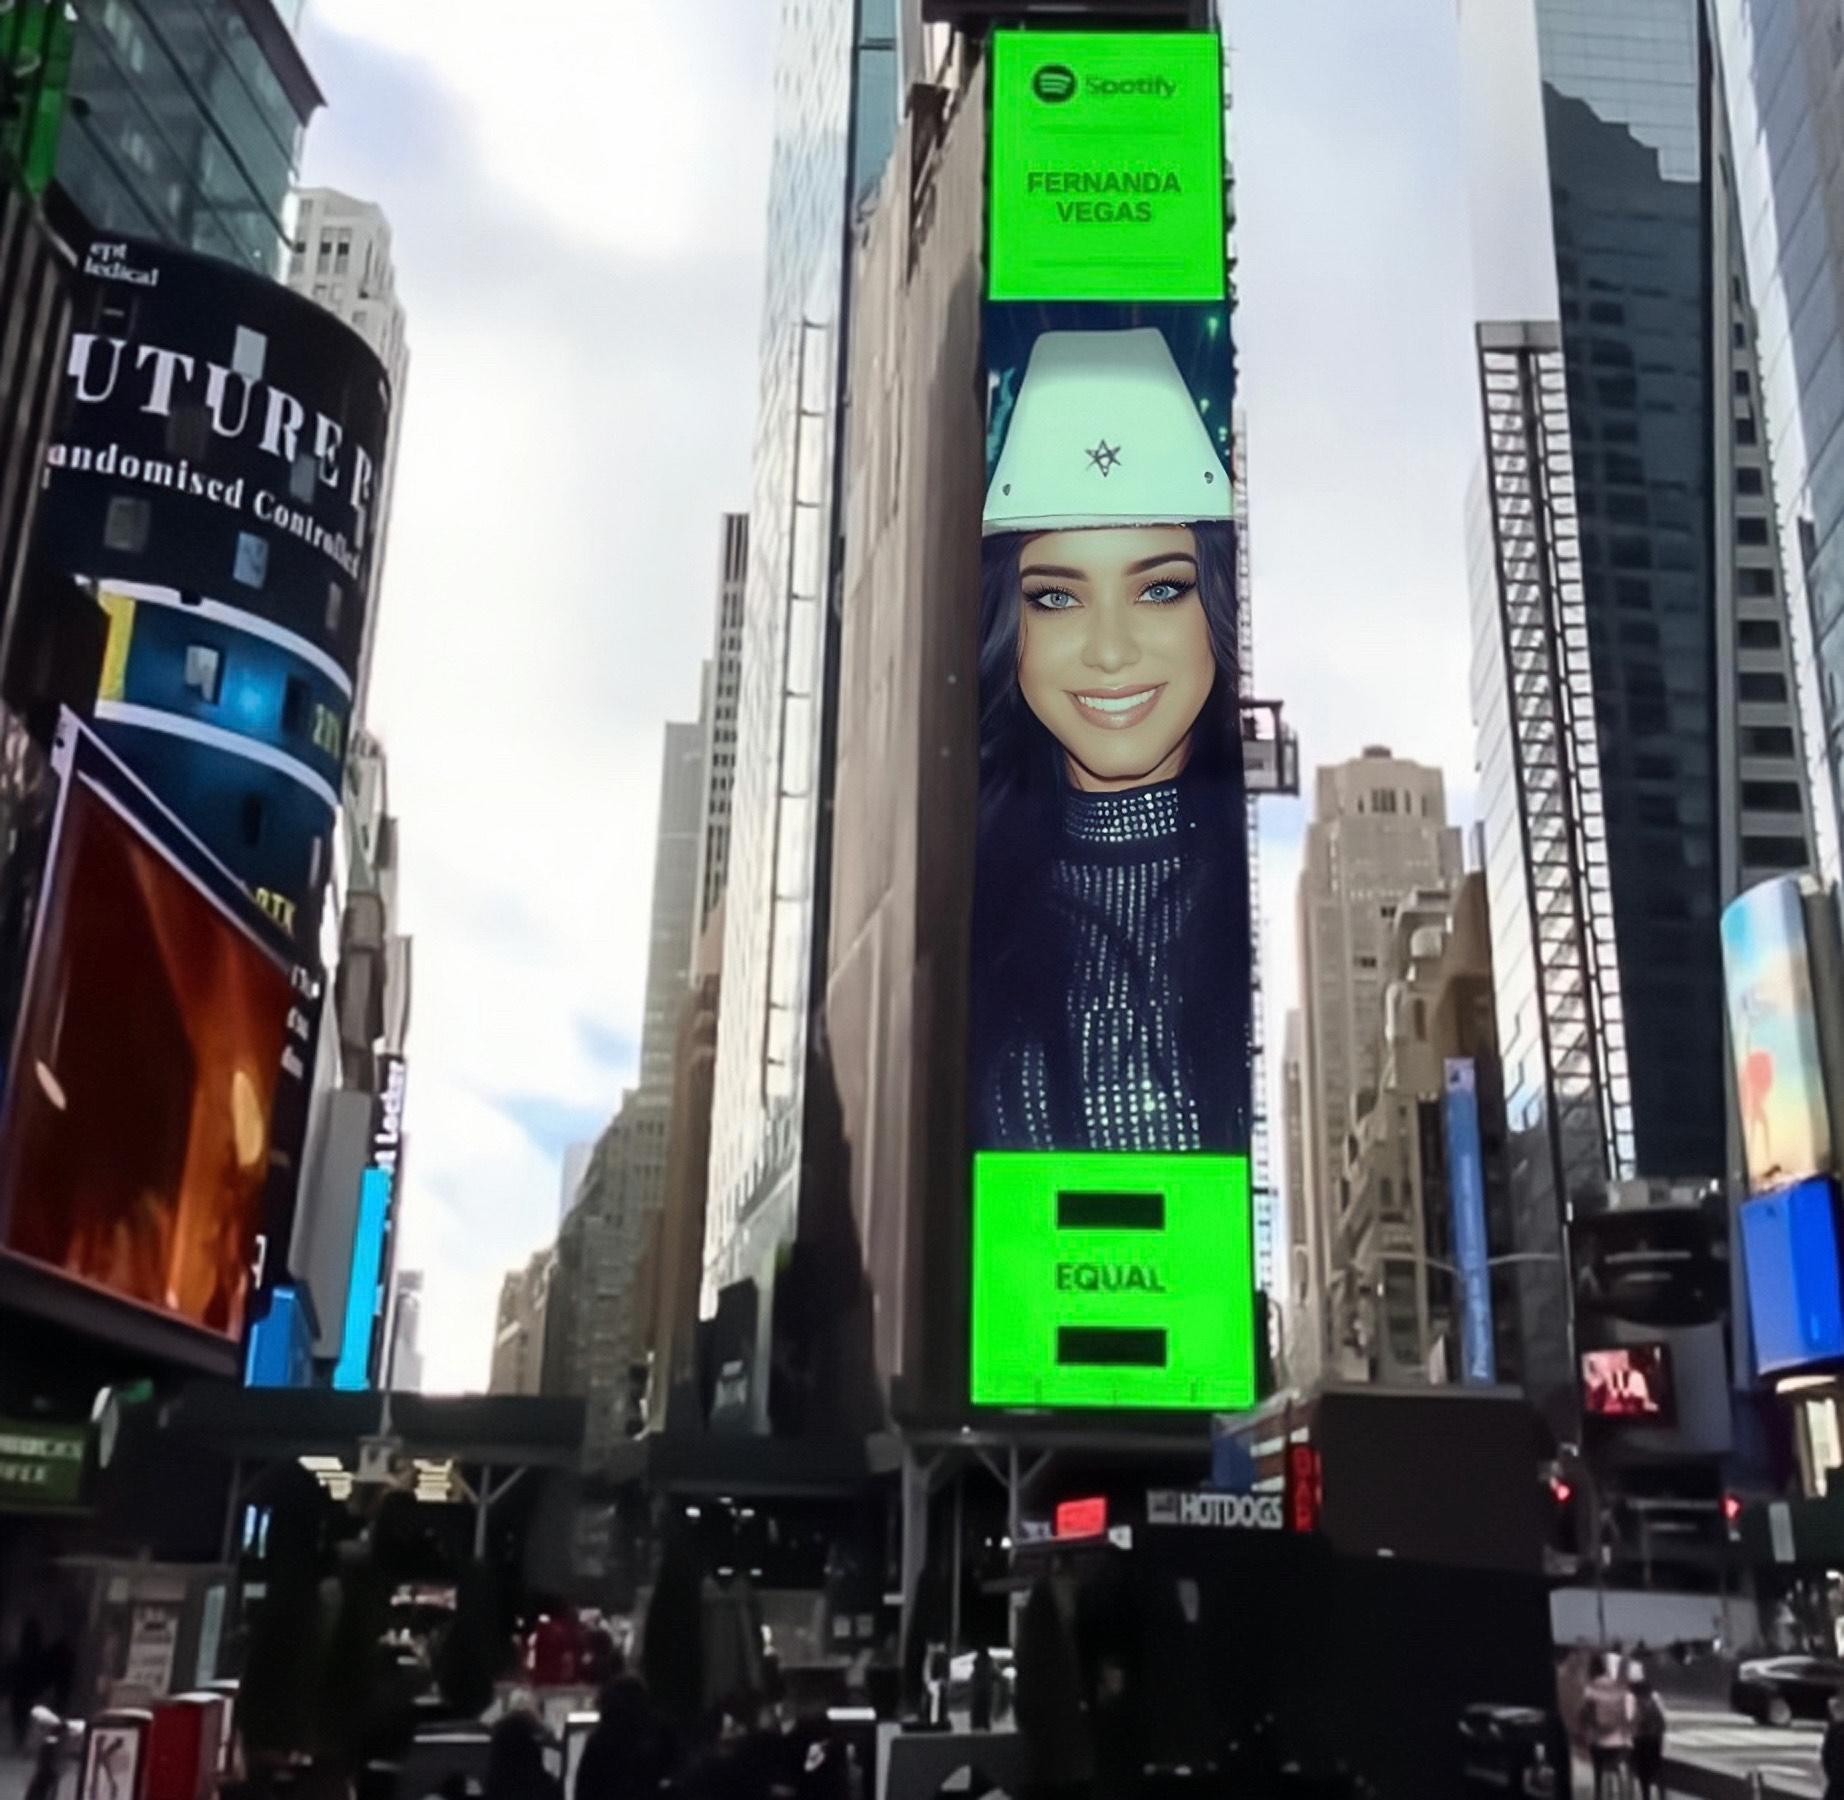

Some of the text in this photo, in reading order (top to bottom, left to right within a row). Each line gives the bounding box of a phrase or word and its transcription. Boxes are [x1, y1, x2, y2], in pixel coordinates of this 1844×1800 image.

[1085, 75, 1177, 98] Spotify
[1027, 171, 1182, 194] FERNANDA
[1056, 201, 1153, 223] VEGAS
[1056, 1262, 1166, 1293] EQUAL
[1180, 1492, 1283, 1529] HOTDOGS
